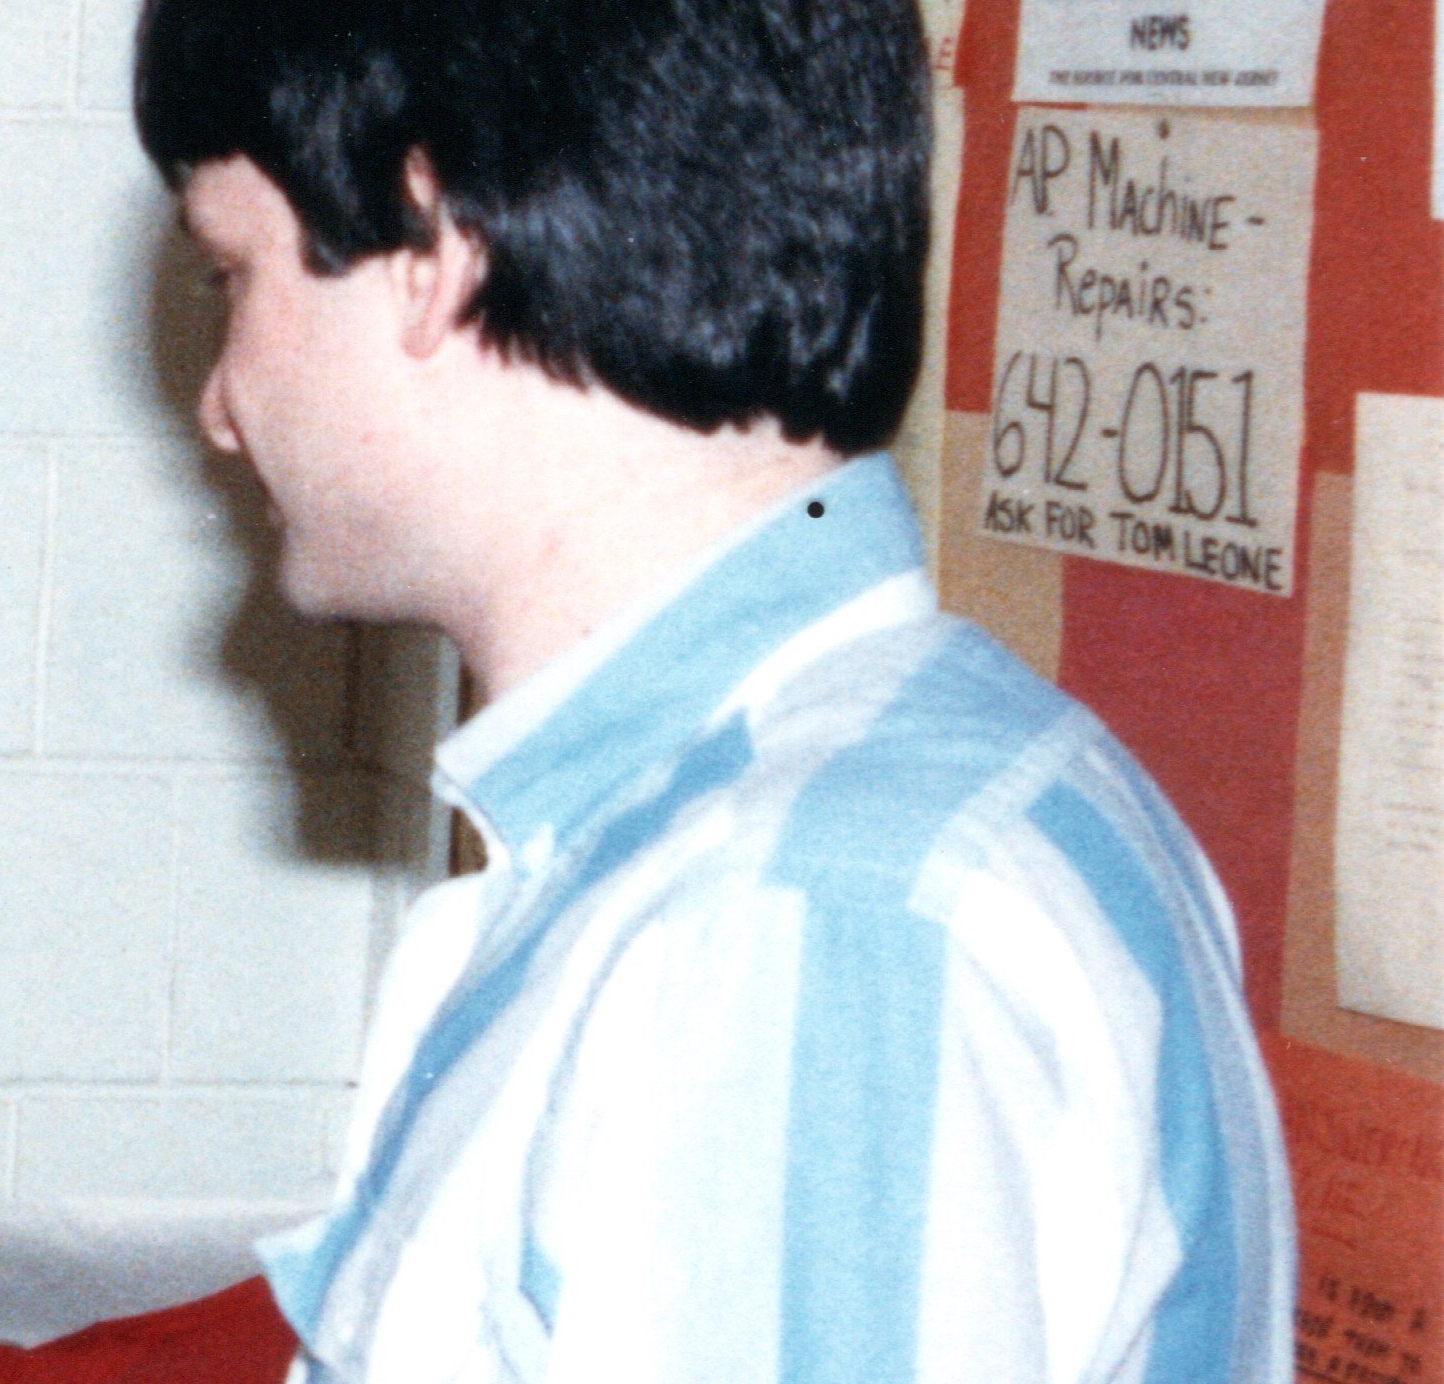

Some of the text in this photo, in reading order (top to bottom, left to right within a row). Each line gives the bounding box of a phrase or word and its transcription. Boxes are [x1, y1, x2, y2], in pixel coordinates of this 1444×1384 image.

[1129, 14, 1191, 51] NEWS
[1010, 124, 1071, 217] AP
[993, 351, 1257, 528] 642-0151
[983, 491, 1285, 592] ASK FOR TOM LEONE
